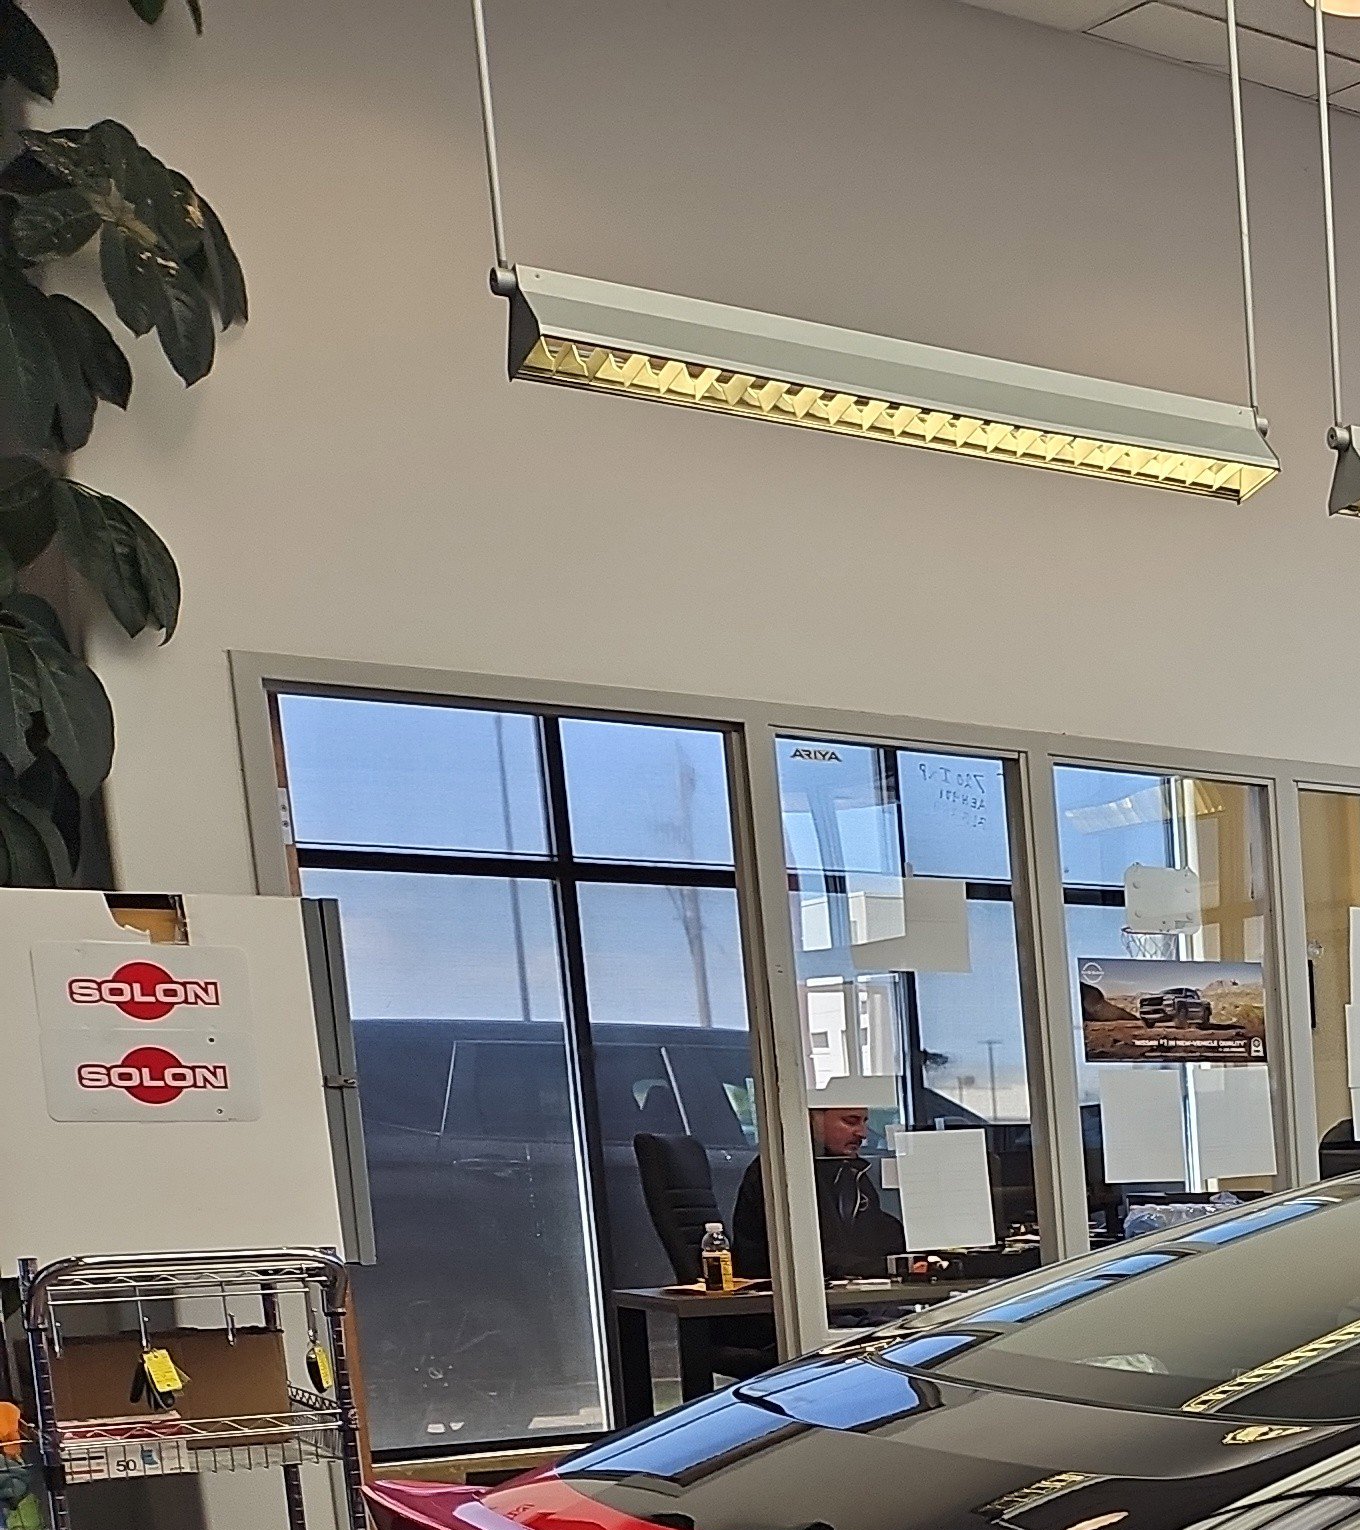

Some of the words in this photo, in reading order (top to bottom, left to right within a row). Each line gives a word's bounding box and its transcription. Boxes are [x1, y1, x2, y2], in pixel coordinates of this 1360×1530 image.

[790, 748, 842, 762] ARIYA
[69, 979, 219, 1005] SOLON
[78, 1064, 228, 1089] SOLON
[116, 1460, 136, 1472] 50
